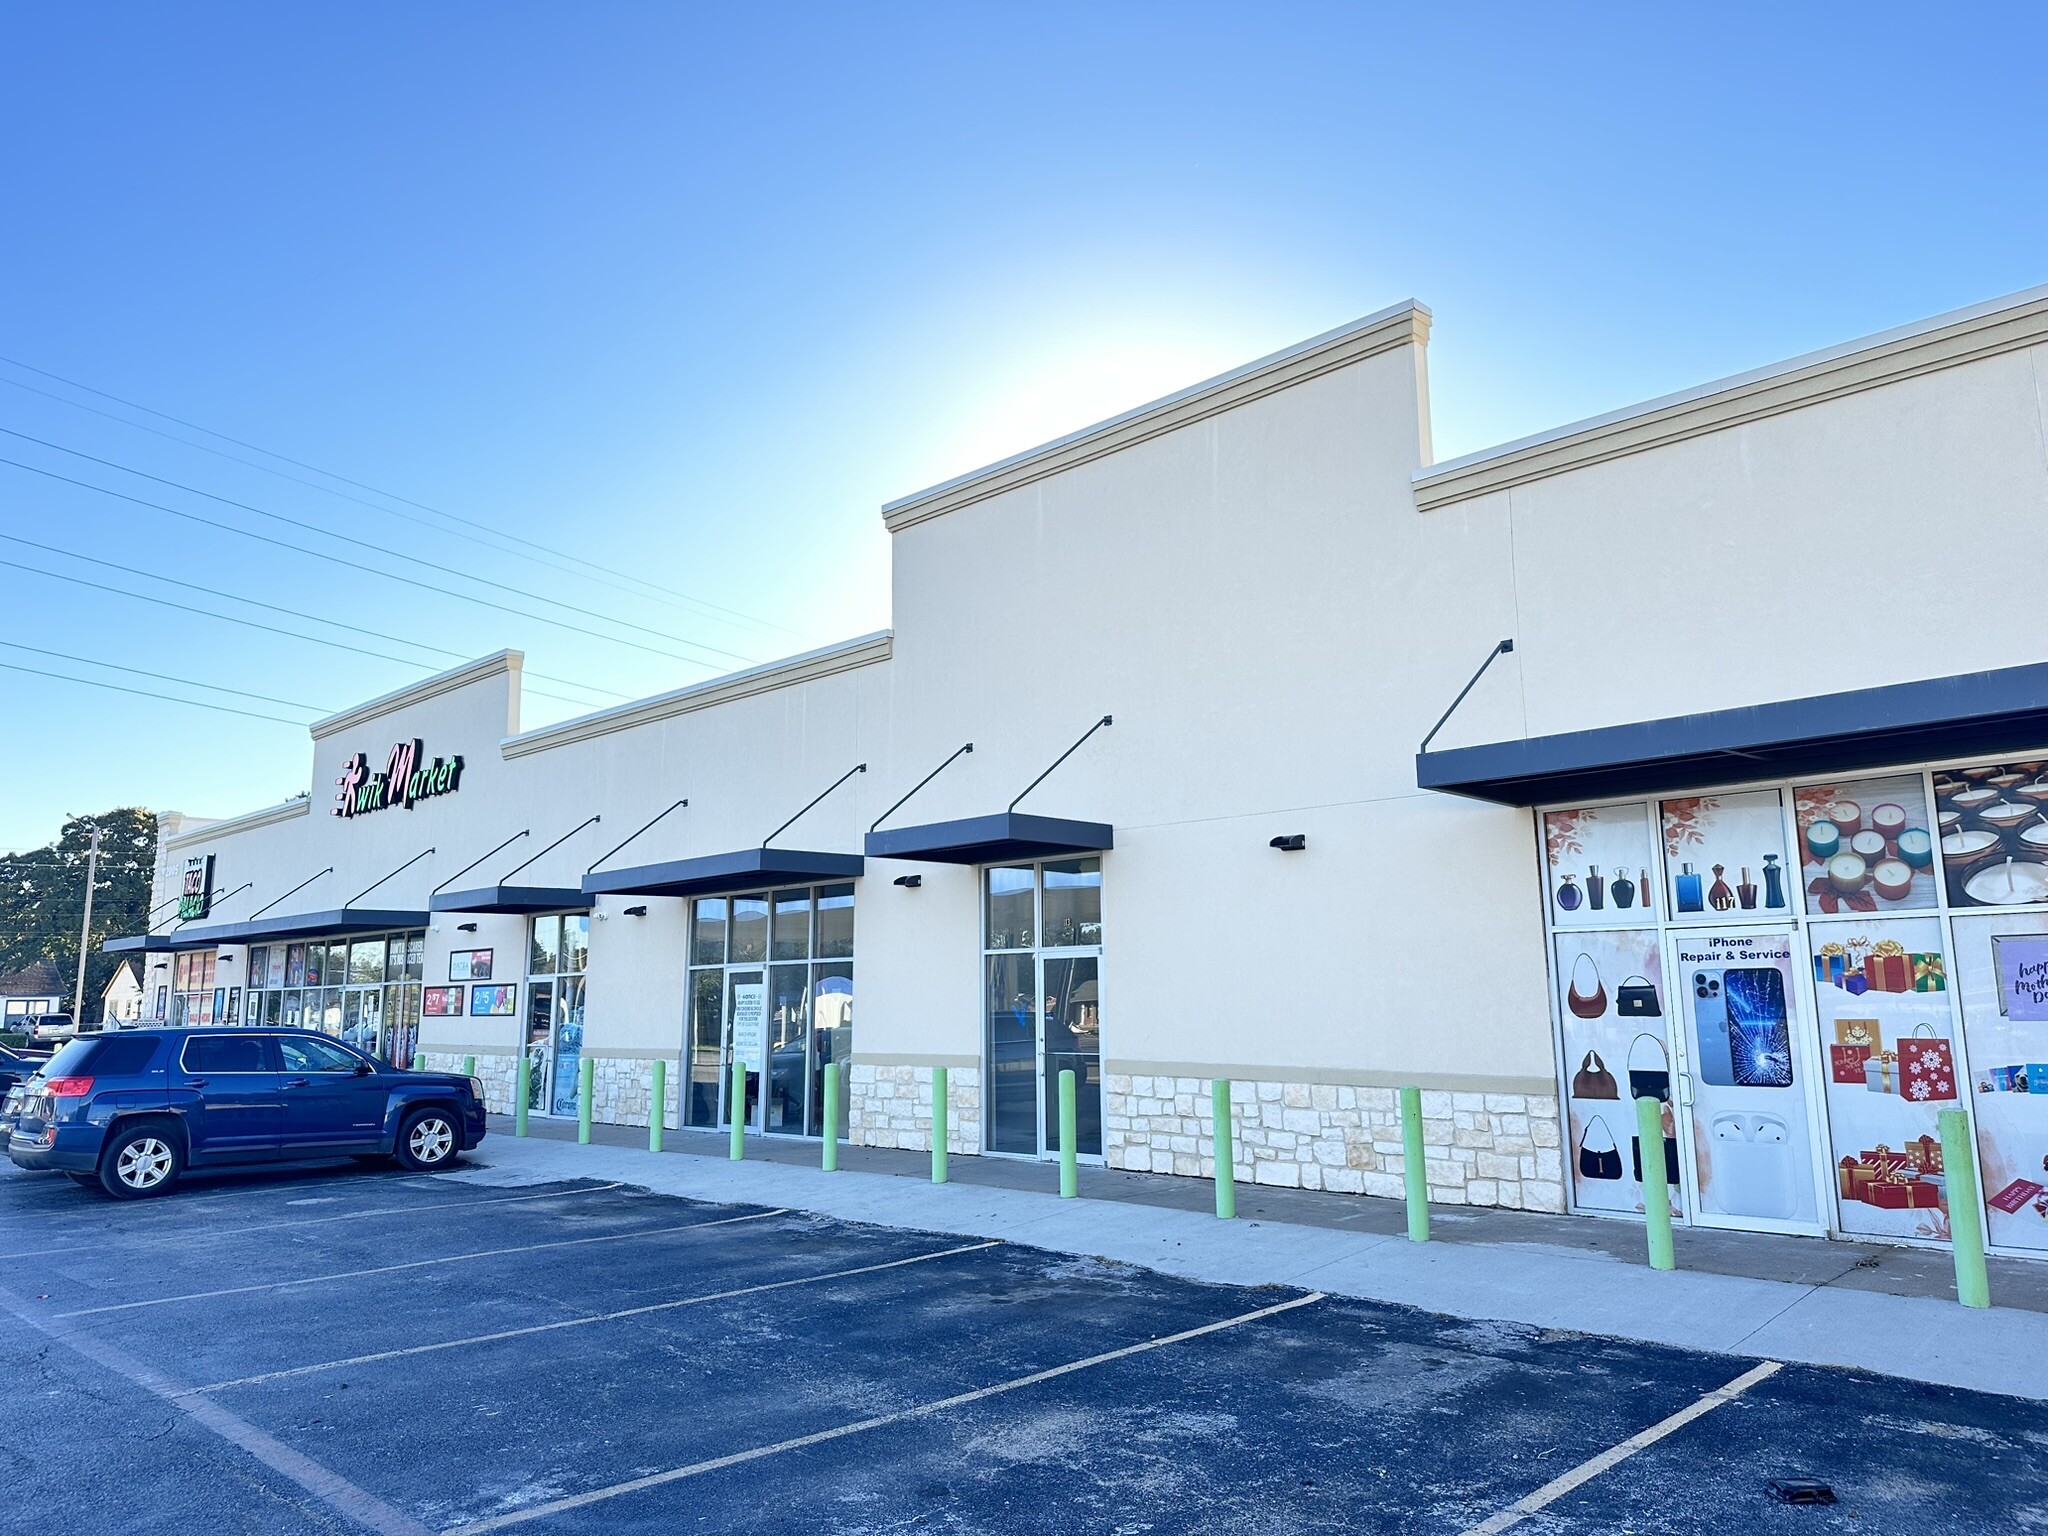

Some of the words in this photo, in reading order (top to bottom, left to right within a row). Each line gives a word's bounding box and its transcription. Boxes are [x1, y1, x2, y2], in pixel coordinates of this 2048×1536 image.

[334, 753, 386, 818] Kwik
[387, 739, 464, 809] Market
[185, 868, 203, 895] TACO
[1716, 896, 1735, 910] 117
[1709, 938, 1753, 947] iPhone
[1680, 952, 1721, 963] Repair
[1725, 951, 1735, 960] &
[1739, 949, 1791, 960] Service
[2002, 1186, 2022, 1201] HAPPY
[2005, 1185, 2036, 1209] BIRTHDAY
